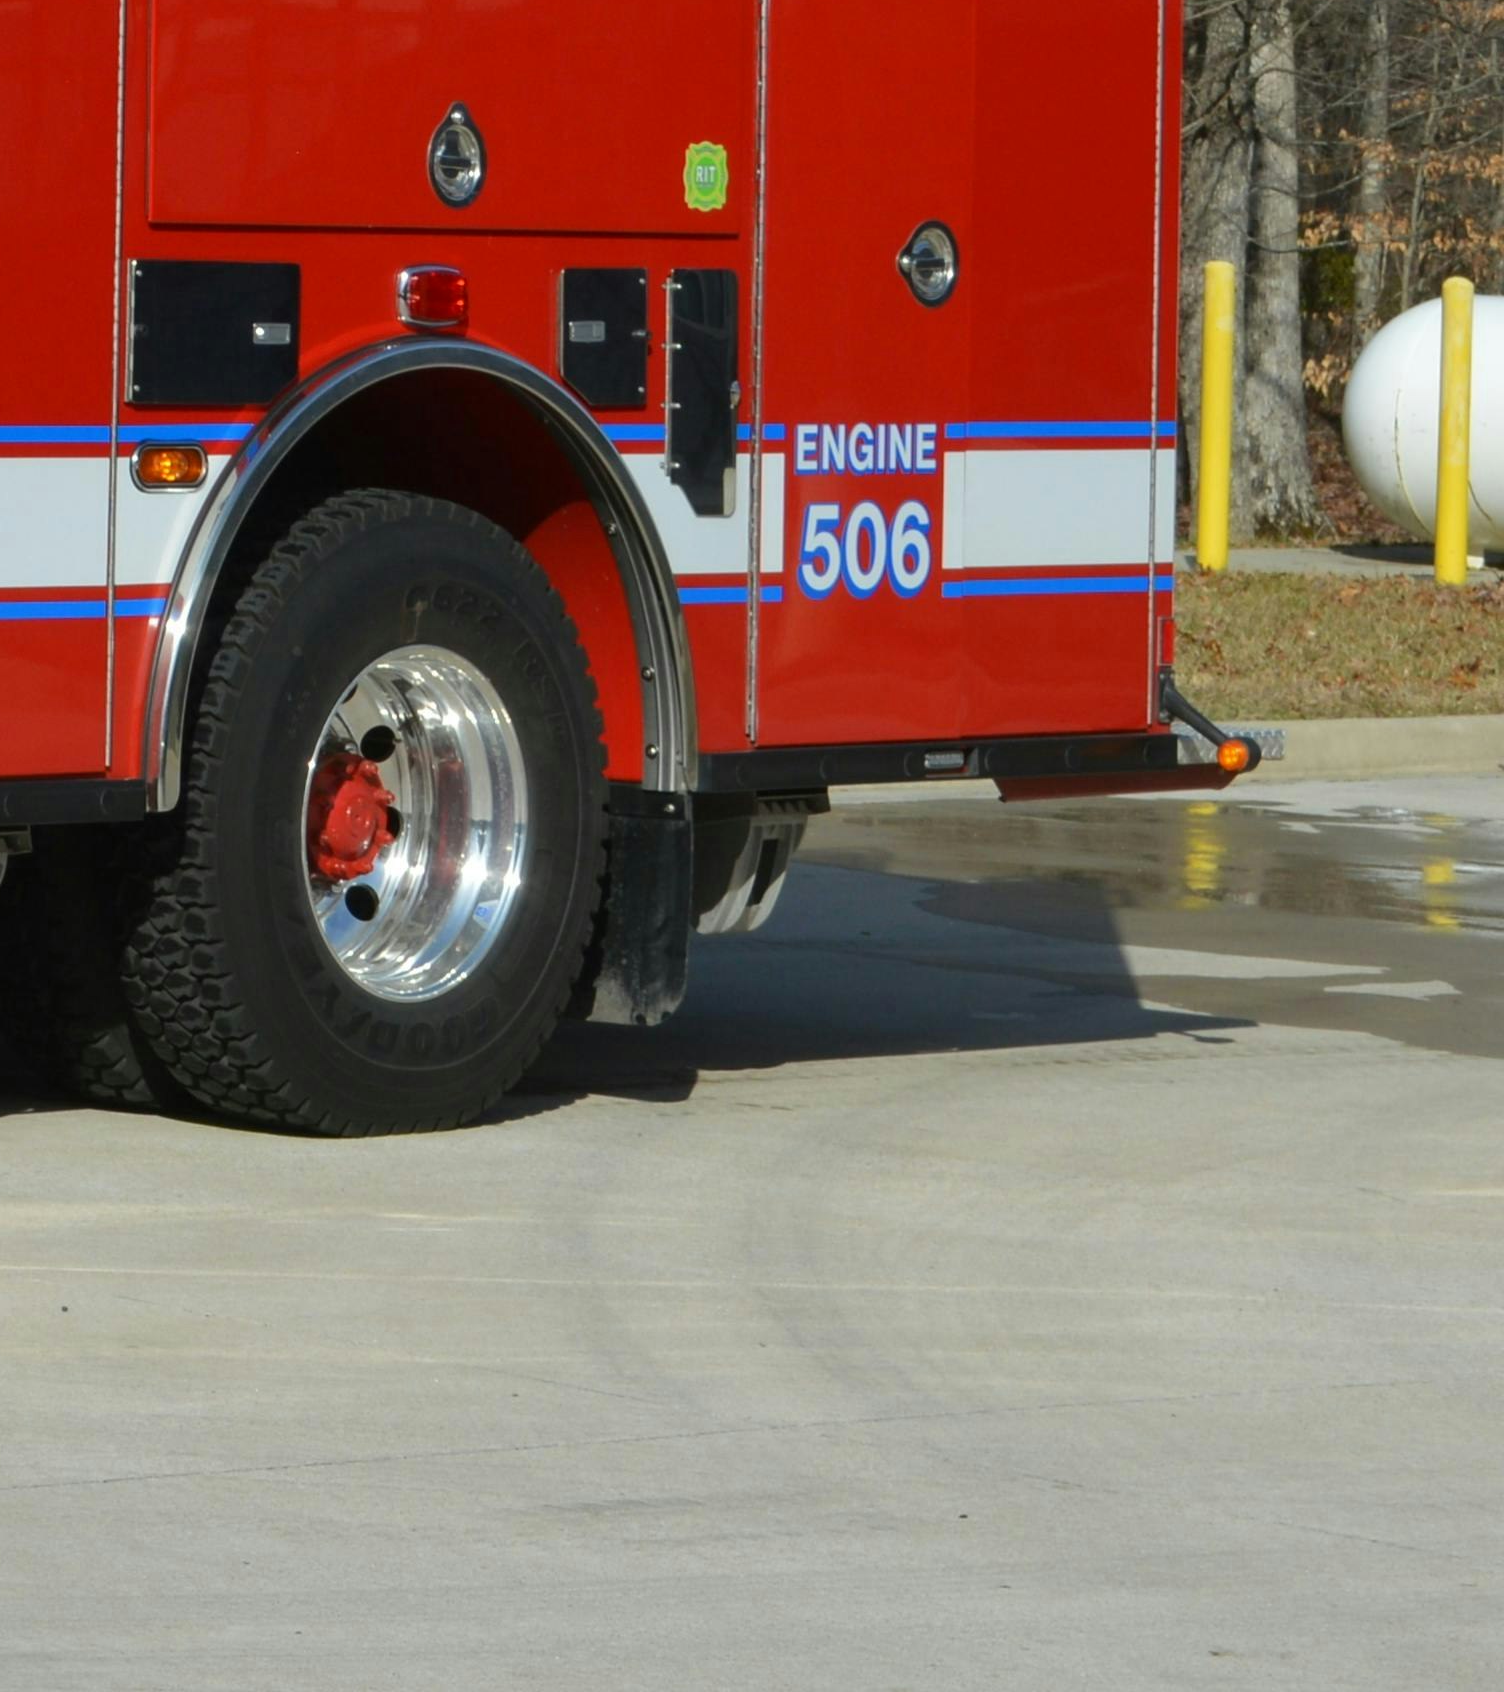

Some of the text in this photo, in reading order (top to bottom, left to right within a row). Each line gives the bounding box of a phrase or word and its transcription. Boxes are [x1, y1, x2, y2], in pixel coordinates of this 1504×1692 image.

[695, 165, 716, 183] RIT
[793, 422, 937, 476] ENGINE
[796, 499, 933, 601] 506
